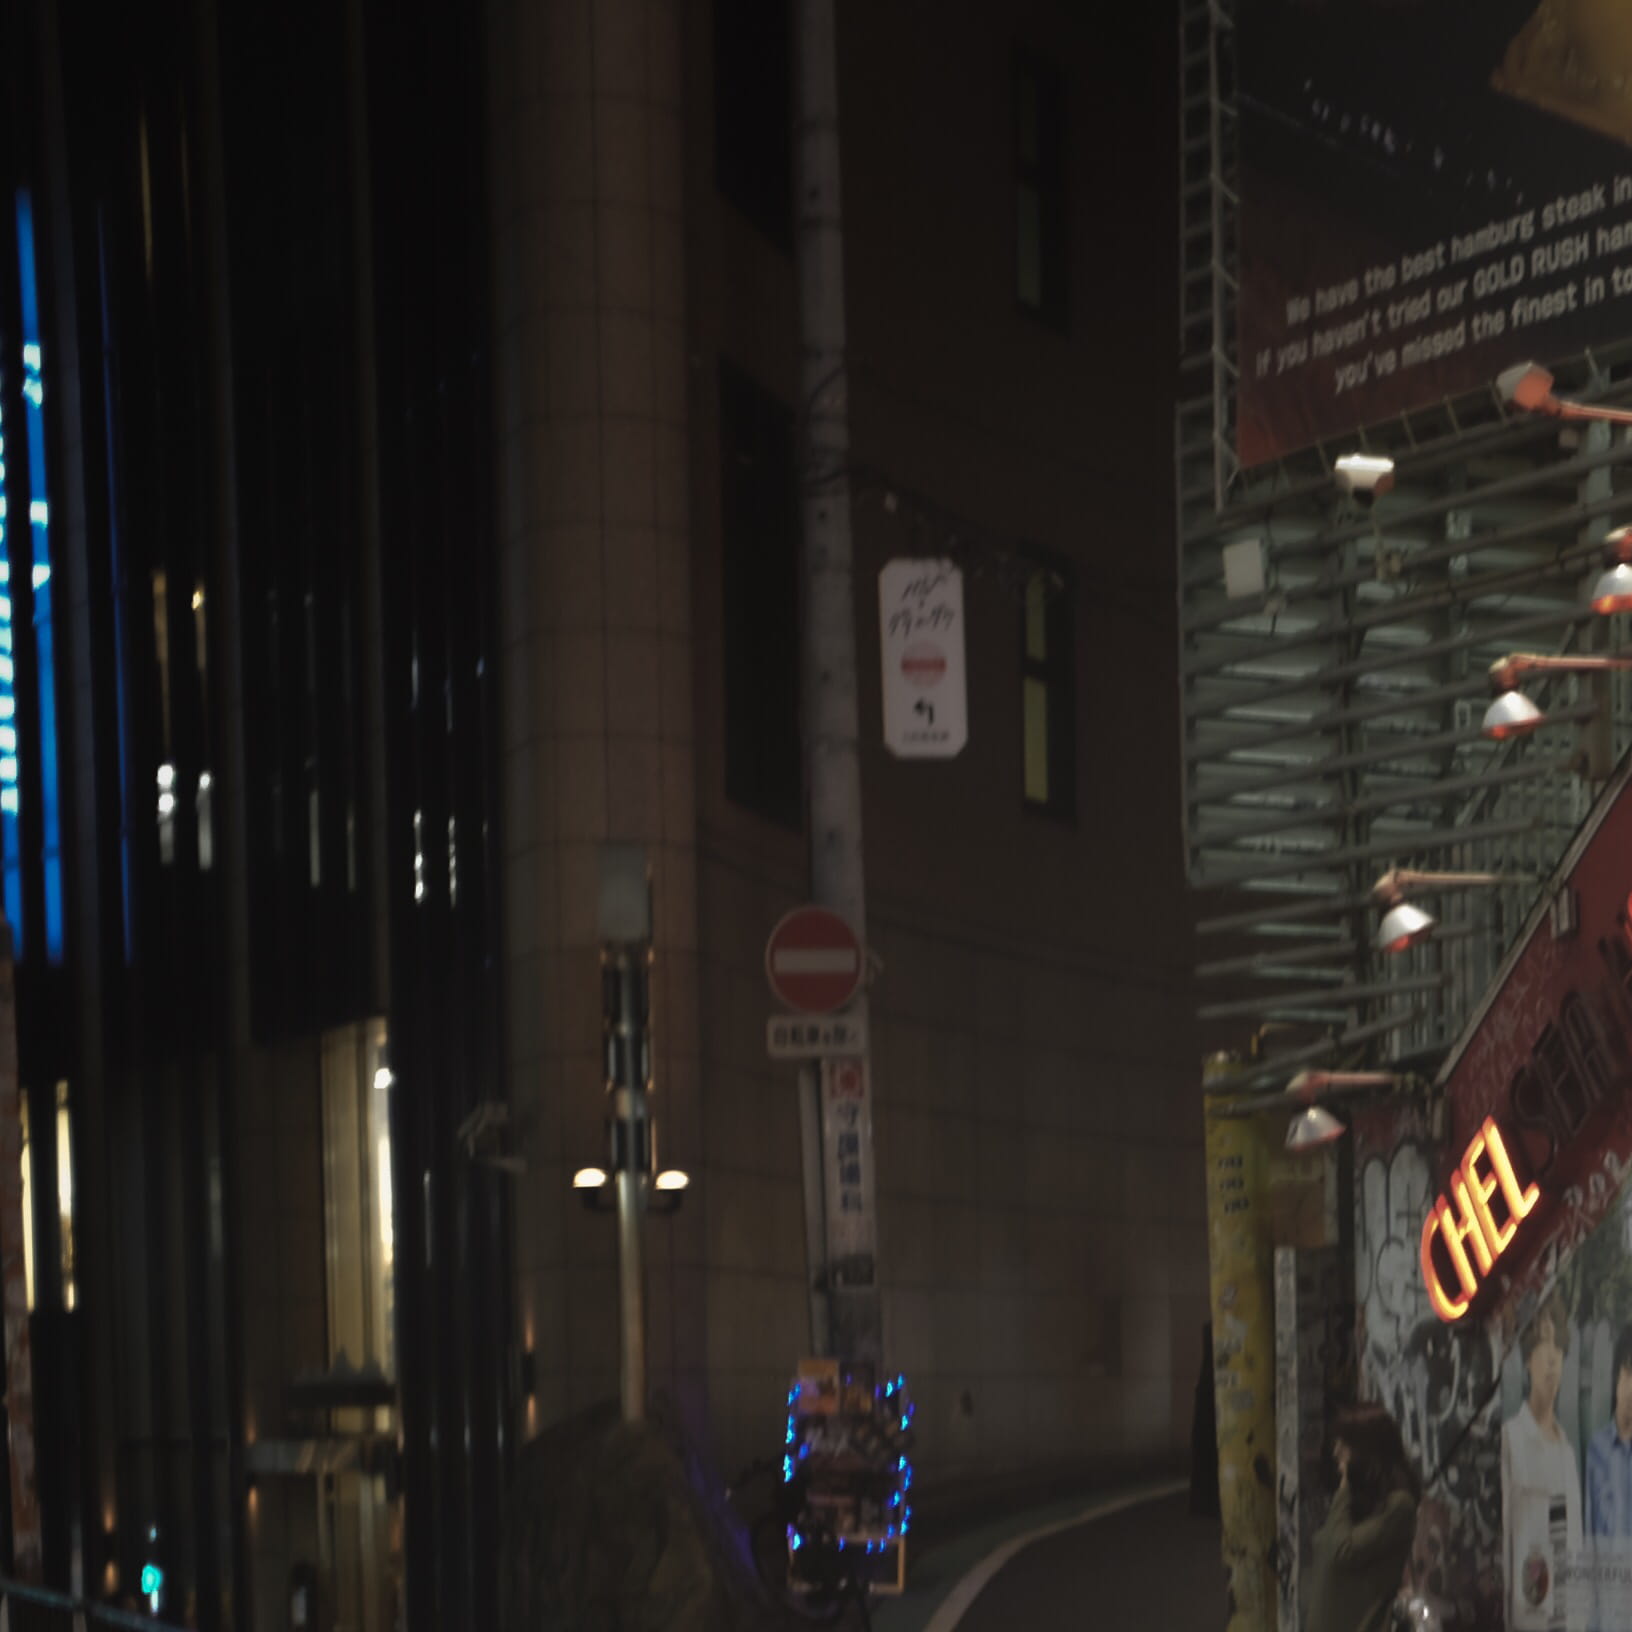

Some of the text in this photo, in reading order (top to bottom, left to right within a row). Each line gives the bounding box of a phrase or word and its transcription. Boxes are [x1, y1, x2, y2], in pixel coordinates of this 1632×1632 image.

[1276, 339, 1308, 376] you
[1312, 307, 1382, 357] haven't
[1387, 288, 1432, 331] tried
[1436, 278, 1469, 314] our
[1472, 254, 1525, 299] GOLD
[1531, 231, 1590, 278] RUSH
[1315, 277, 1359, 317] have
[1364, 263, 1397, 297] the
[1402, 241, 1446, 285] best
[1451, 208, 1535, 264] hamburg
[1542, 184, 1606, 231] steak
[1613, 175, 1632, 206] in
[1335, 349, 1397, 395] you've
[1401, 317, 1466, 369] missed
[1471, 307, 1506, 344] the
[1511, 280, 1578, 329] finest
[1584, 275, 1605, 307] in
